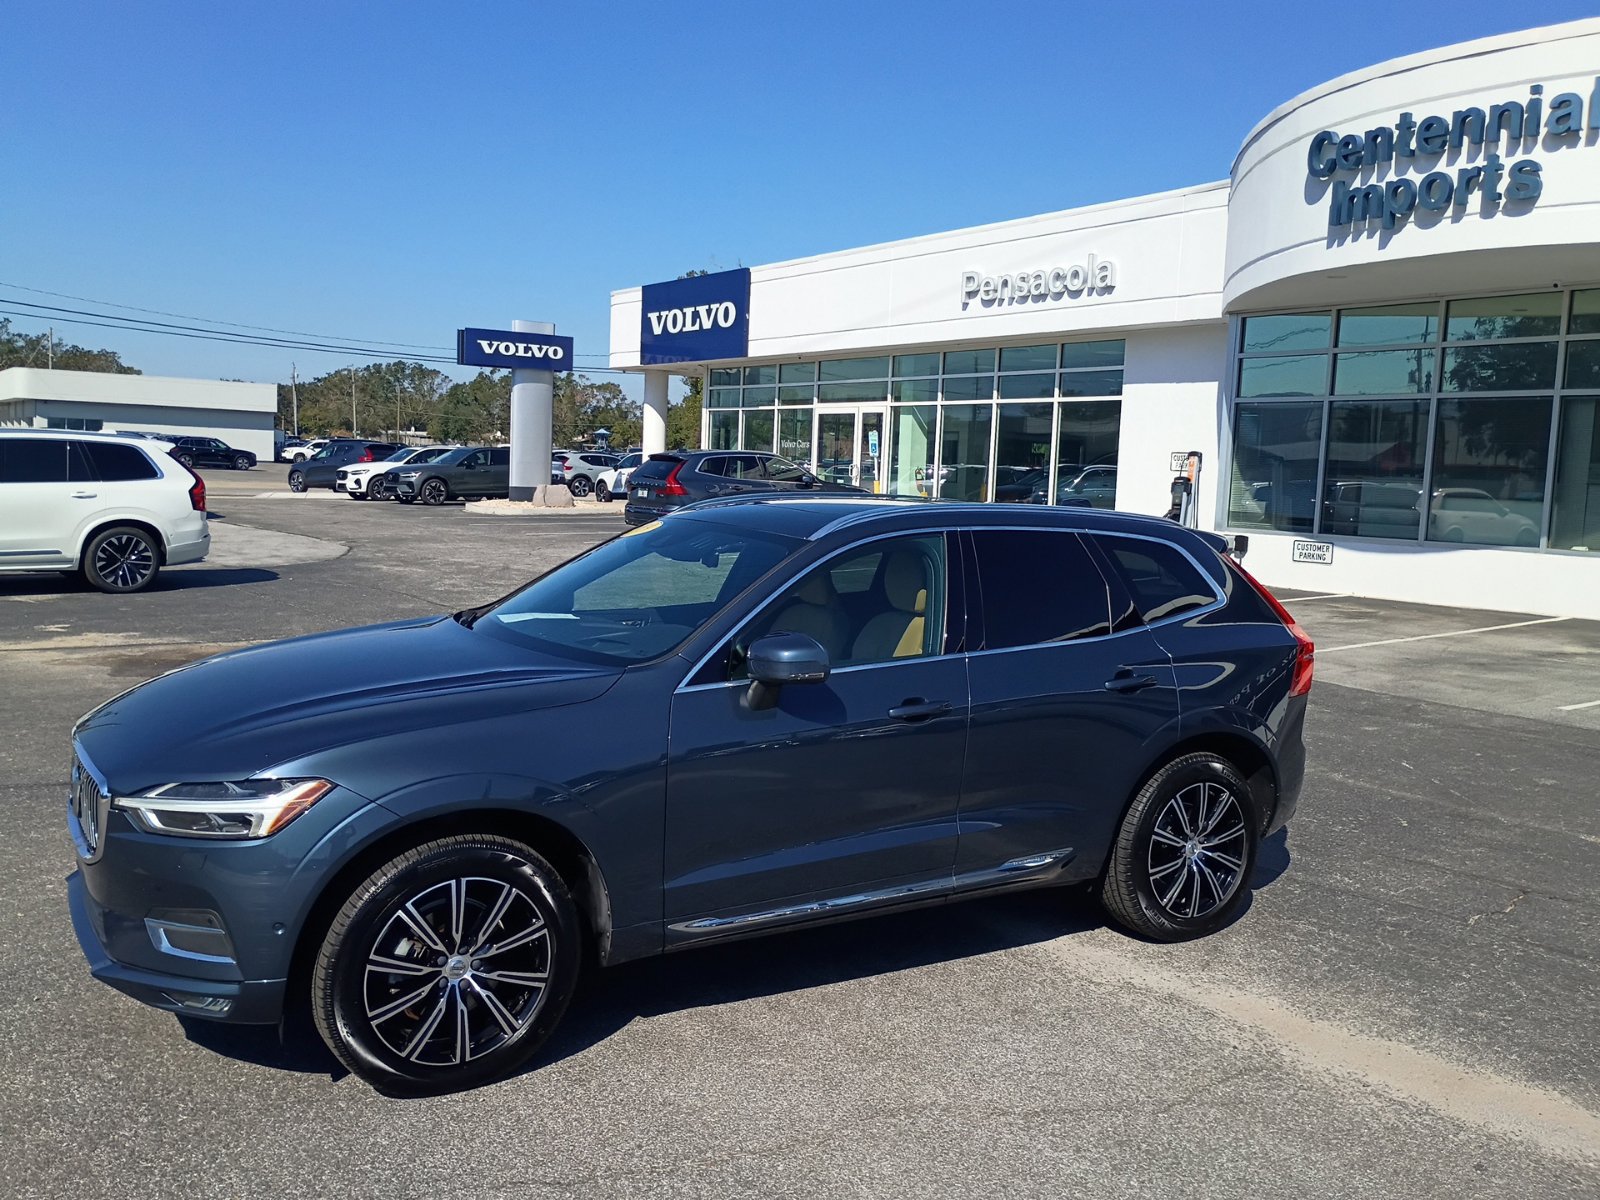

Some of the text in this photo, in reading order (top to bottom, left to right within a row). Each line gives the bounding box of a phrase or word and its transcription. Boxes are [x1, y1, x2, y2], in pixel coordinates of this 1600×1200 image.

[1307, 75, 1600, 178] Centennial
[1329, 153, 1543, 230] Imports
[961, 252, 1116, 304] Pensacola
[648, 301, 736, 336] VOLVO
[477, 339, 564, 360] VOLVO
[1296, 543, 1330, 553] CUSTOMER
[1298, 551, 1326, 561] PARKING
